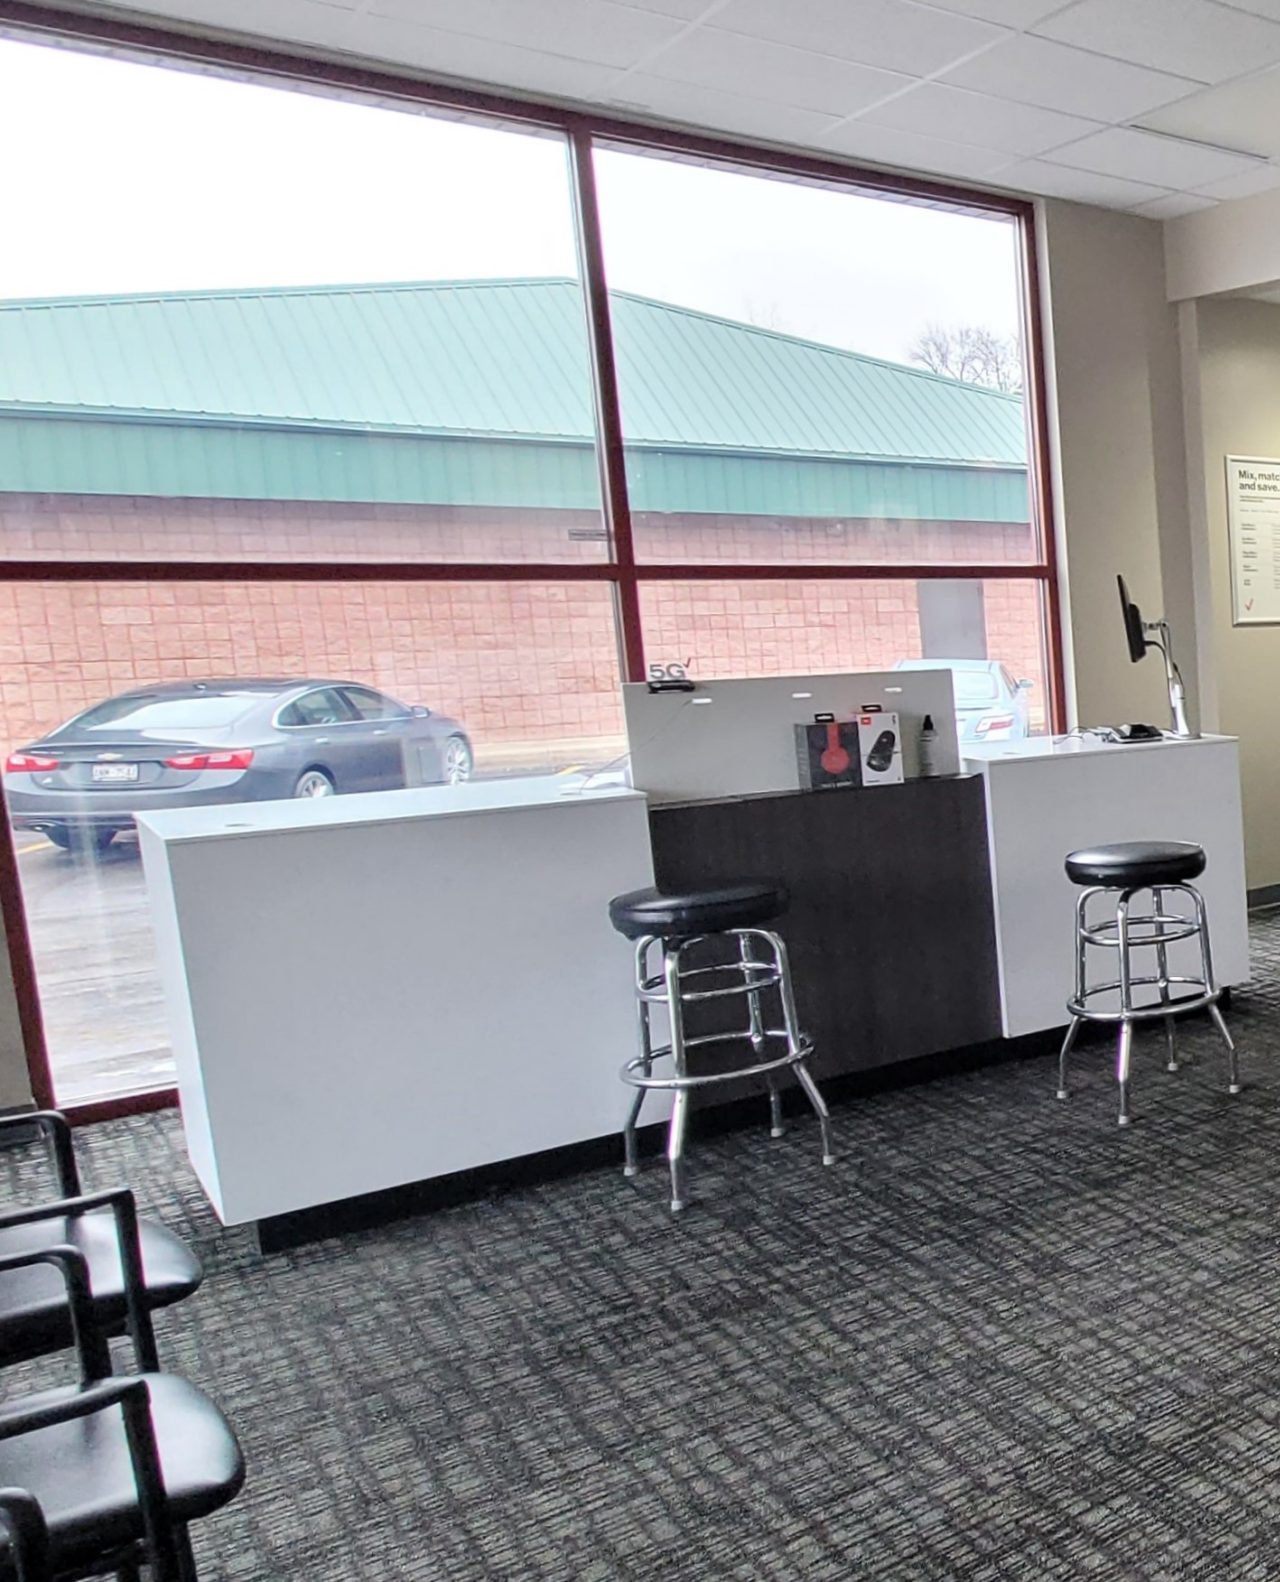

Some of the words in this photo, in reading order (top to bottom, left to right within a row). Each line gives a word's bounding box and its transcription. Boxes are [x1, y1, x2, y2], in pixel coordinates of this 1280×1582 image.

[1238, 469, 1257, 480] Mix,
[1239, 482, 1256, 491] and
[1257, 484, 1280, 492] save.
[650, 663, 686, 679] 5G
